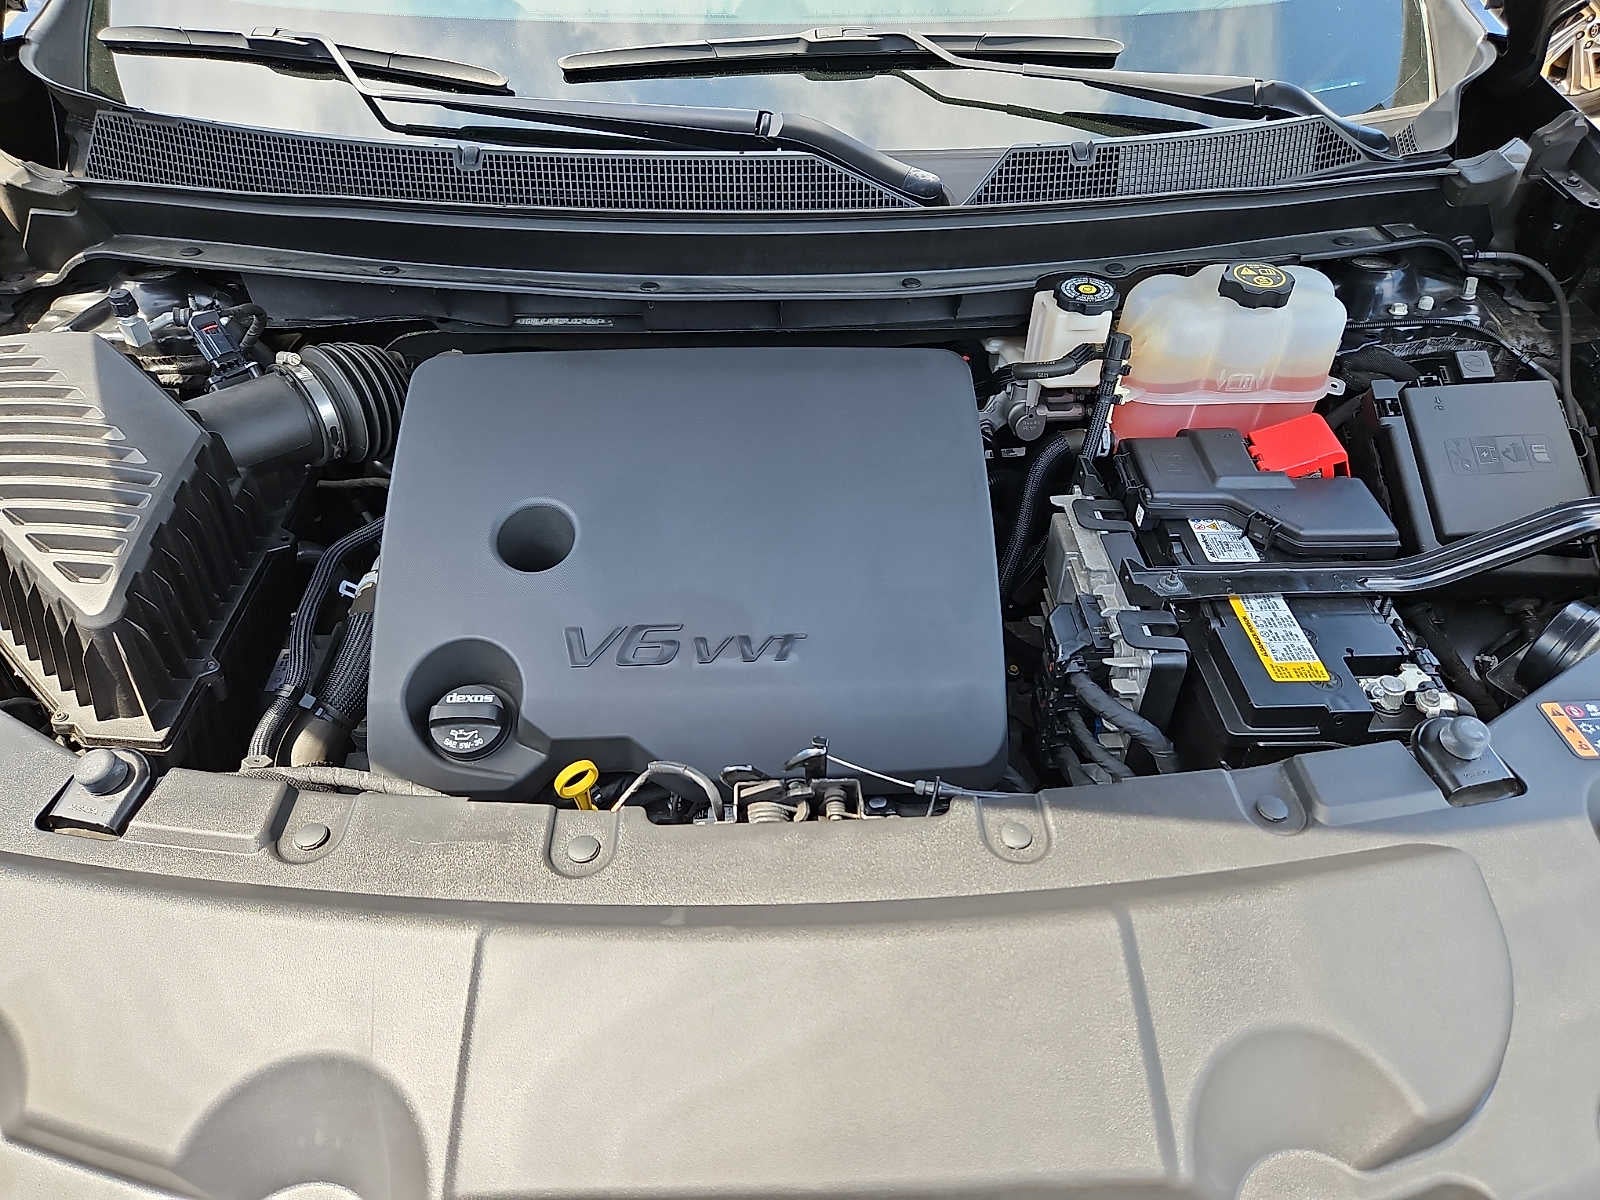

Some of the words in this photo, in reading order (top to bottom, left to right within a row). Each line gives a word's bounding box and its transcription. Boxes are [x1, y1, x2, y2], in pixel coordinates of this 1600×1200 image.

[563, 624, 684, 667] V6
[694, 633, 808, 664] VVT
[446, 692, 496, 704] dexos
[443, 738, 458, 748] SAE
[459, 738, 484, 749] 5W-30
